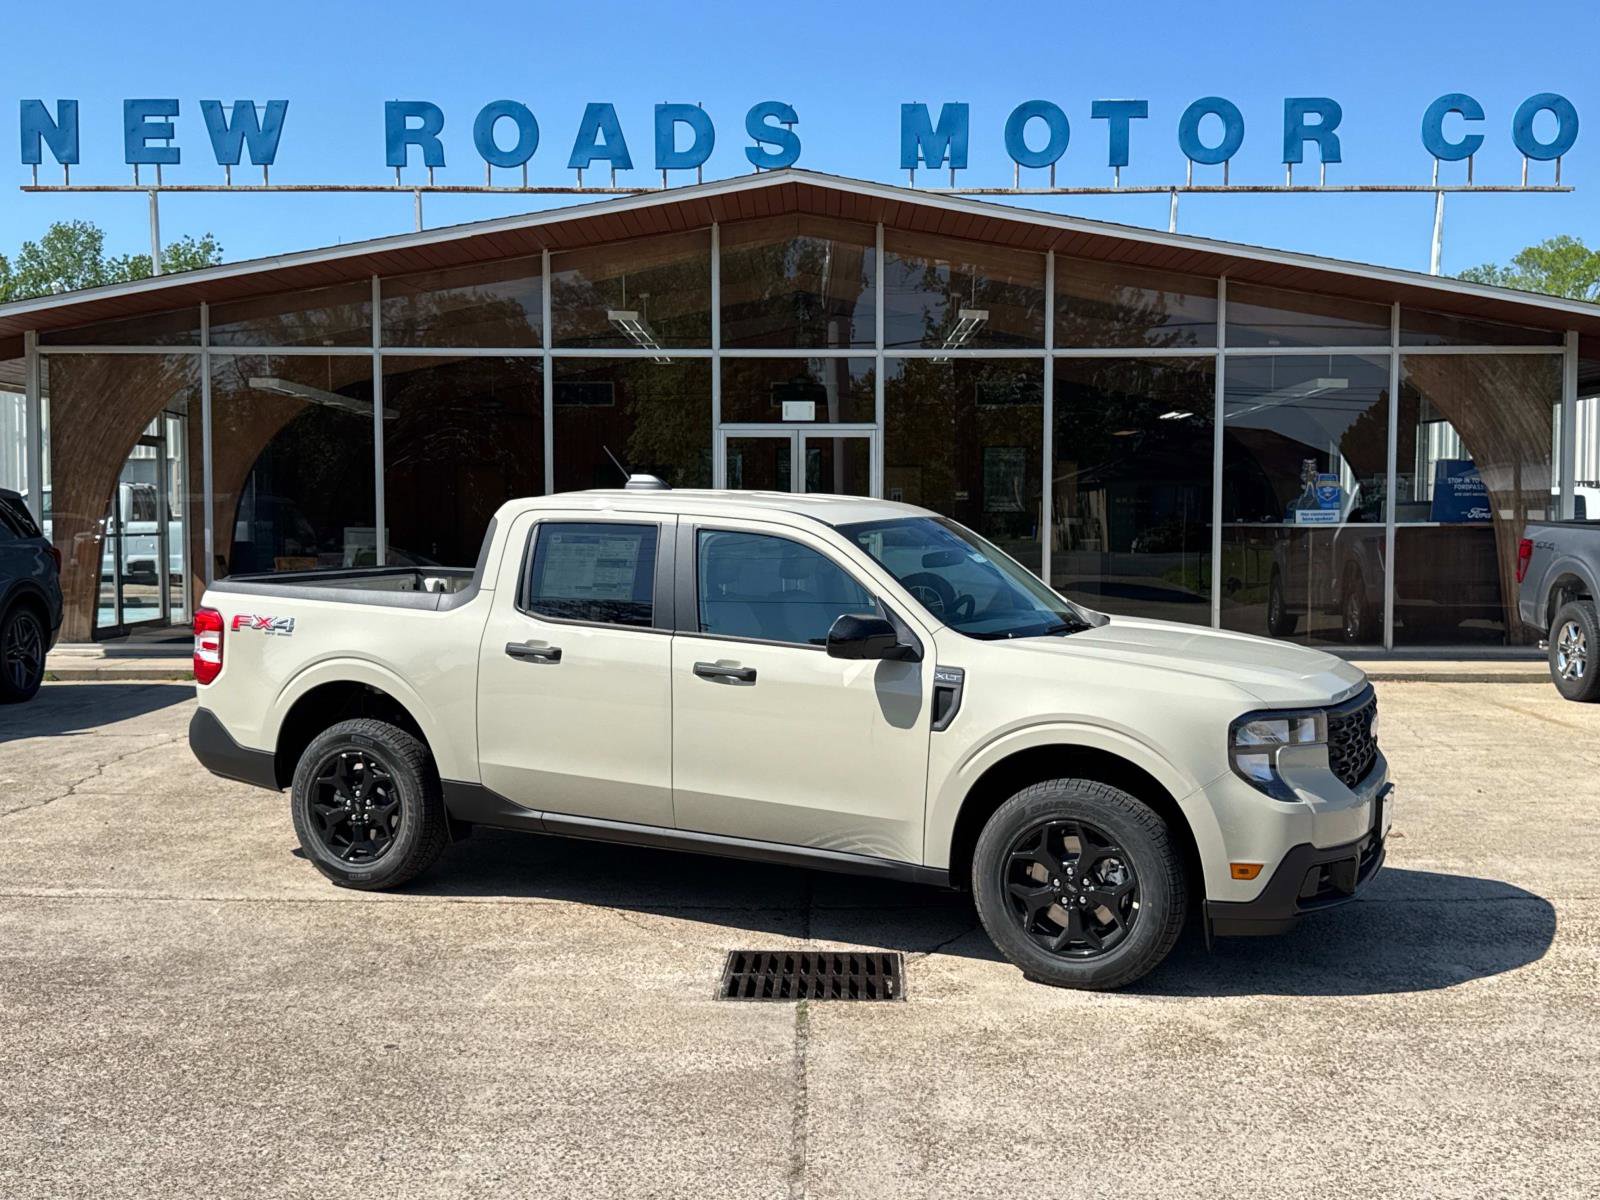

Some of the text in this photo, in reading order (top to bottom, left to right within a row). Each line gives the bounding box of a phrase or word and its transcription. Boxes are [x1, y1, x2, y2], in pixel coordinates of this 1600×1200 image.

[20, 92, 1580, 170] NEW ROADS MOTOR CO
[231, 614, 295, 633] FX4
[935, 672, 961, 681] XLT
